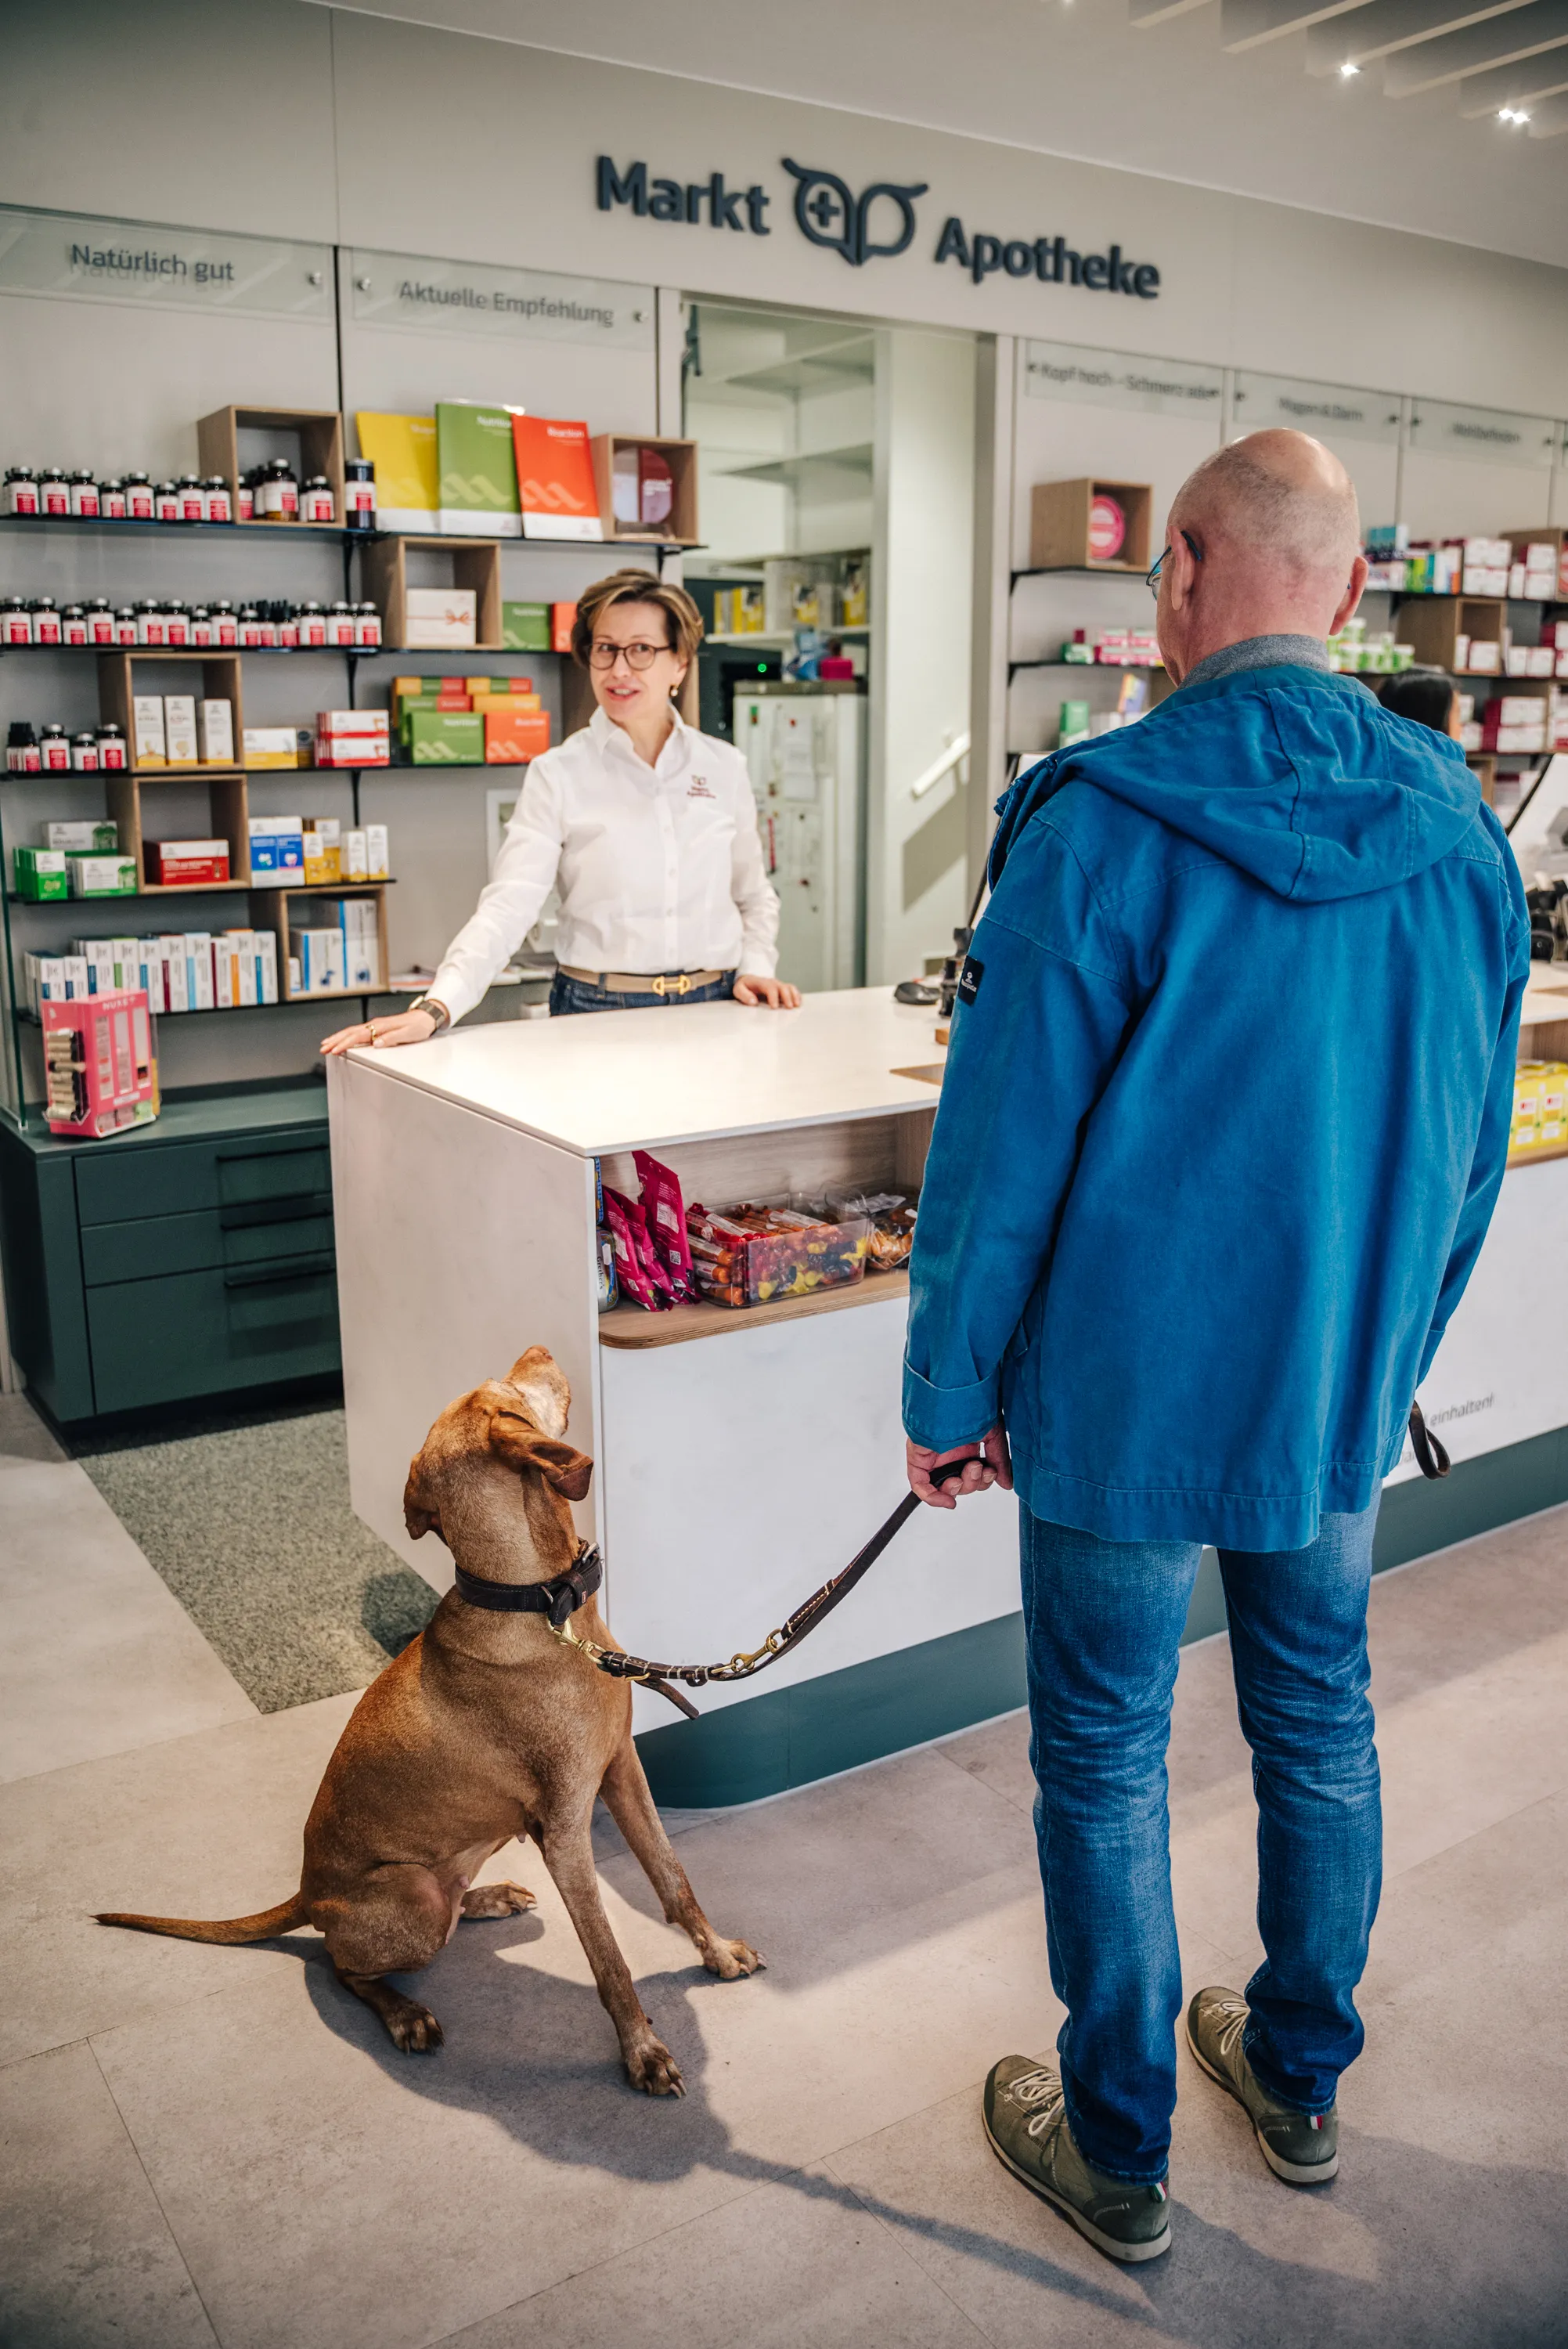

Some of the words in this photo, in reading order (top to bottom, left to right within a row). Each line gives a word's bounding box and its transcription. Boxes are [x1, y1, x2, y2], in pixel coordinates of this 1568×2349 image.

[597, 155, 770, 236] Markt
[71, 244, 188, 275] Natürlich
[195, 261, 236, 283] gut
[934, 217, 1160, 299] Apotheke
[398, 280, 488, 309] Aktuelle
[493, 291, 615, 328] Empfehlung
[597, 1256, 605, 1290] Grether's
[1429, 1392, 1494, 1427] einhalten!
